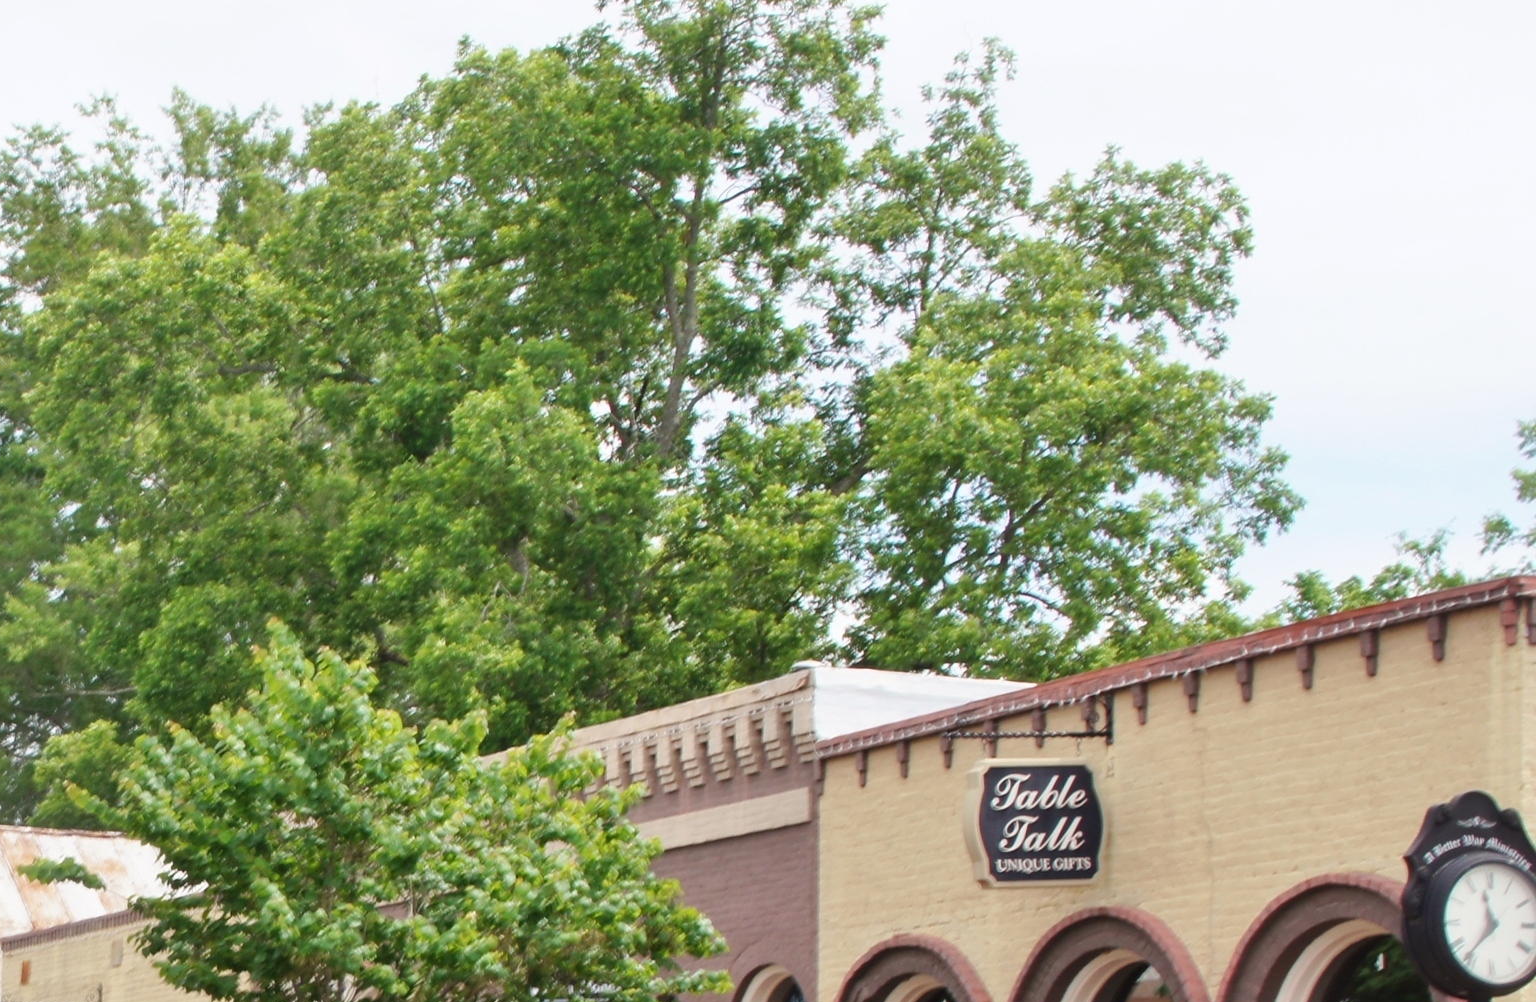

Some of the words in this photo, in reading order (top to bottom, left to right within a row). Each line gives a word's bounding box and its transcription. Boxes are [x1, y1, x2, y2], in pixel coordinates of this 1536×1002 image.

[990, 773, 1088, 811] Table
[998, 815, 1086, 852] Talk
[995, 858, 1051, 874] UNIQUE
[1052, 857, 1092, 871] GIFTS
[1423, 851, 1435, 865] A
[1431, 838, 1461, 857] Better
[1461, 834, 1485, 848] Way
[1485, 837, 1533, 871] Ministries
